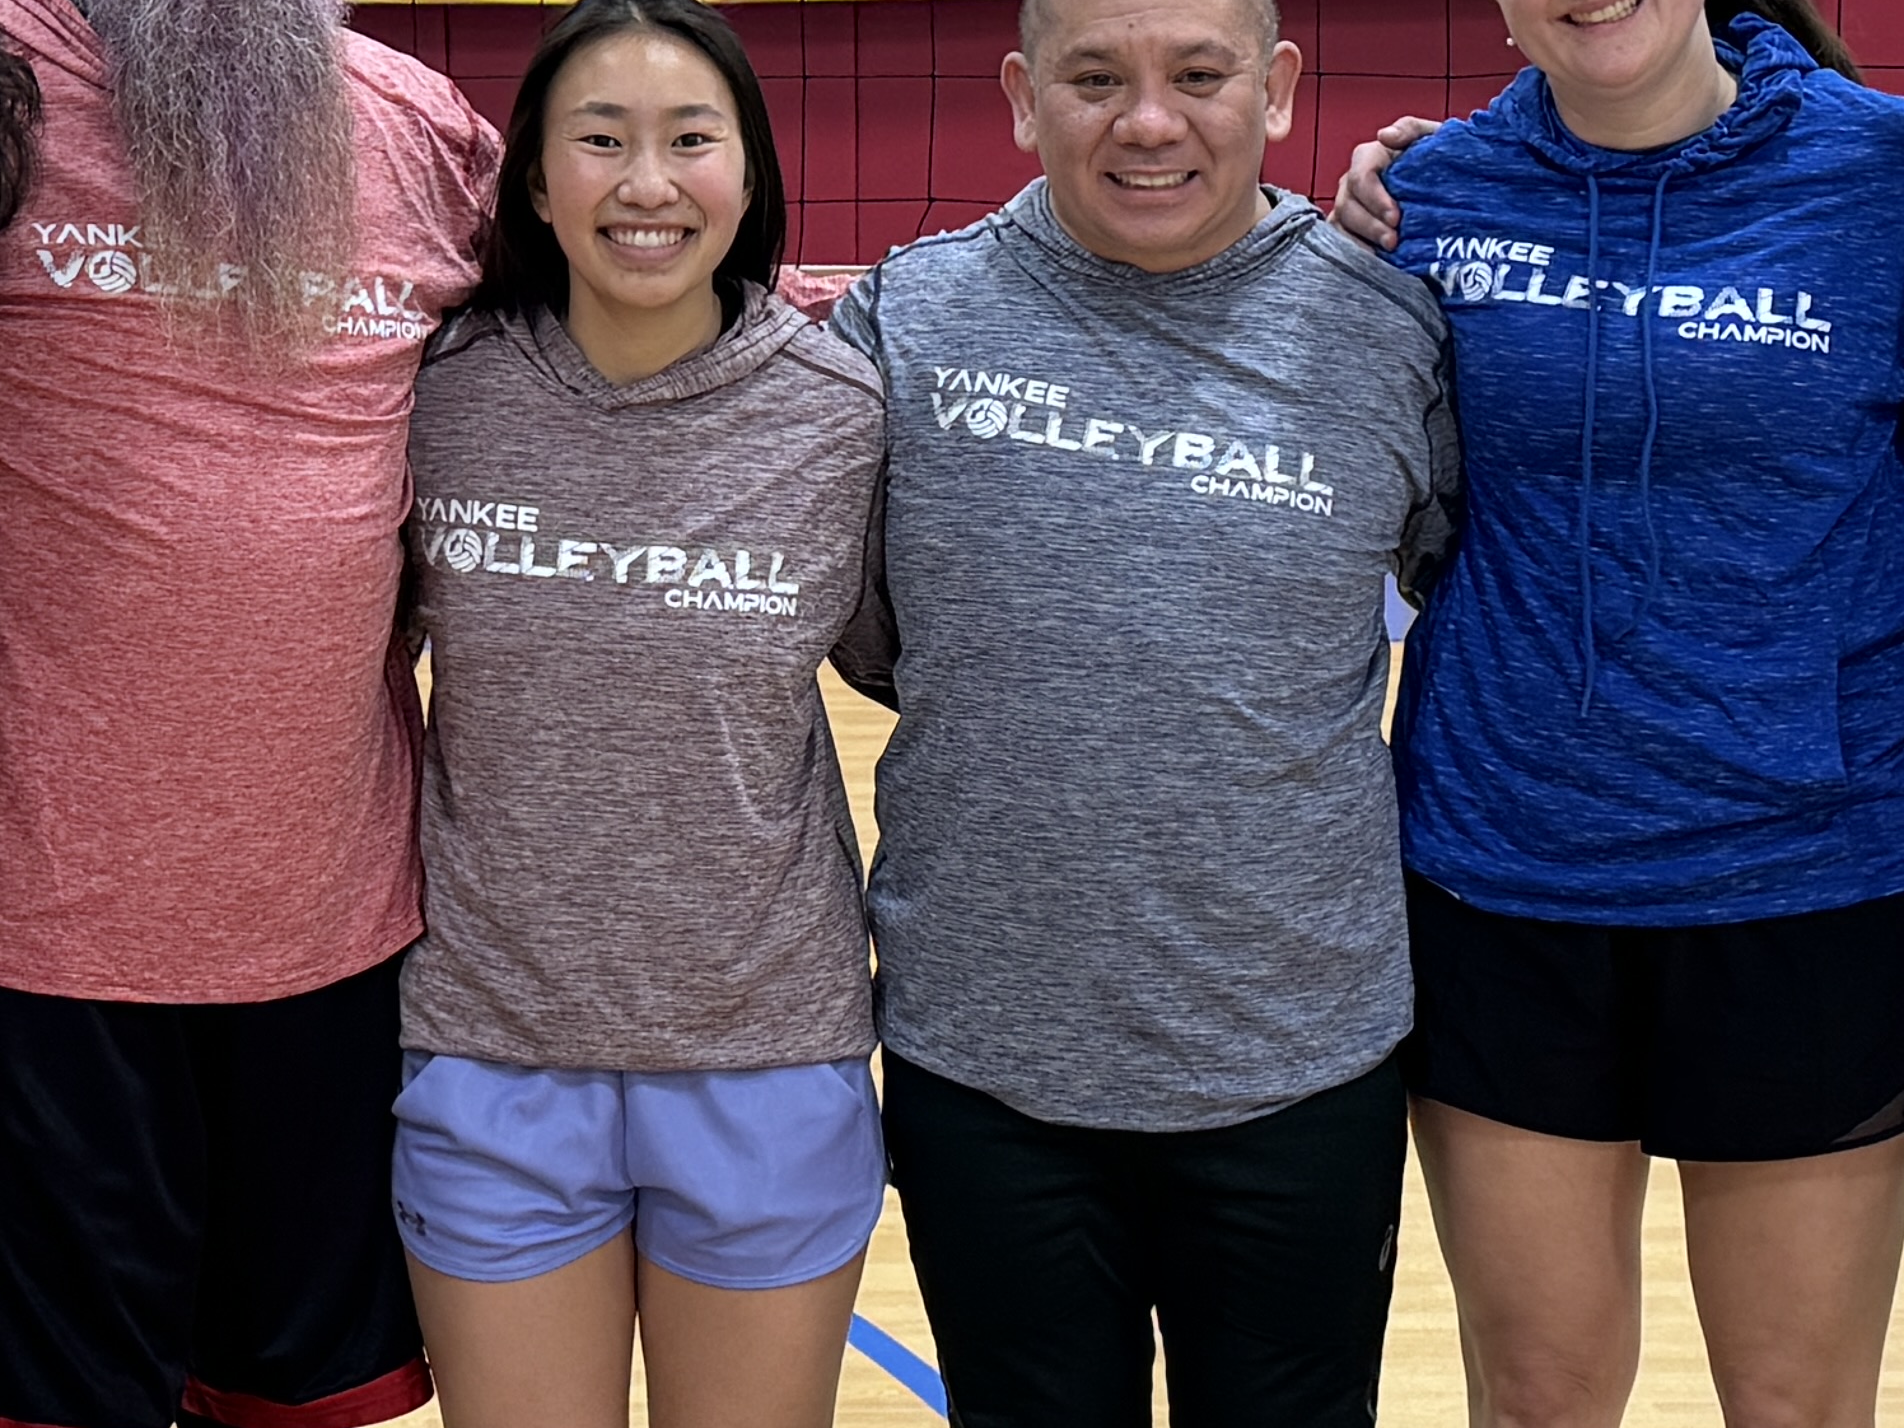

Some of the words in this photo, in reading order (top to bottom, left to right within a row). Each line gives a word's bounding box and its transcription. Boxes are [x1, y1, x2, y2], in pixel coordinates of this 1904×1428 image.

[32, 223, 144, 248] YANK
[1436, 236, 1555, 266] YANKEE
[1429, 260, 1832, 333] VOLLEYBALL
[1678, 320, 1830, 354] CHAMPION
[933, 366, 1071, 408] YANKEE
[930, 391, 1334, 496] VOLLEYBALL
[417, 496, 540, 532] YANKEE
[1190, 474, 1335, 517] CHAMPION
[421, 526, 800, 595] VOLLEYBALL
[664, 587, 798, 617] CHAMPION
